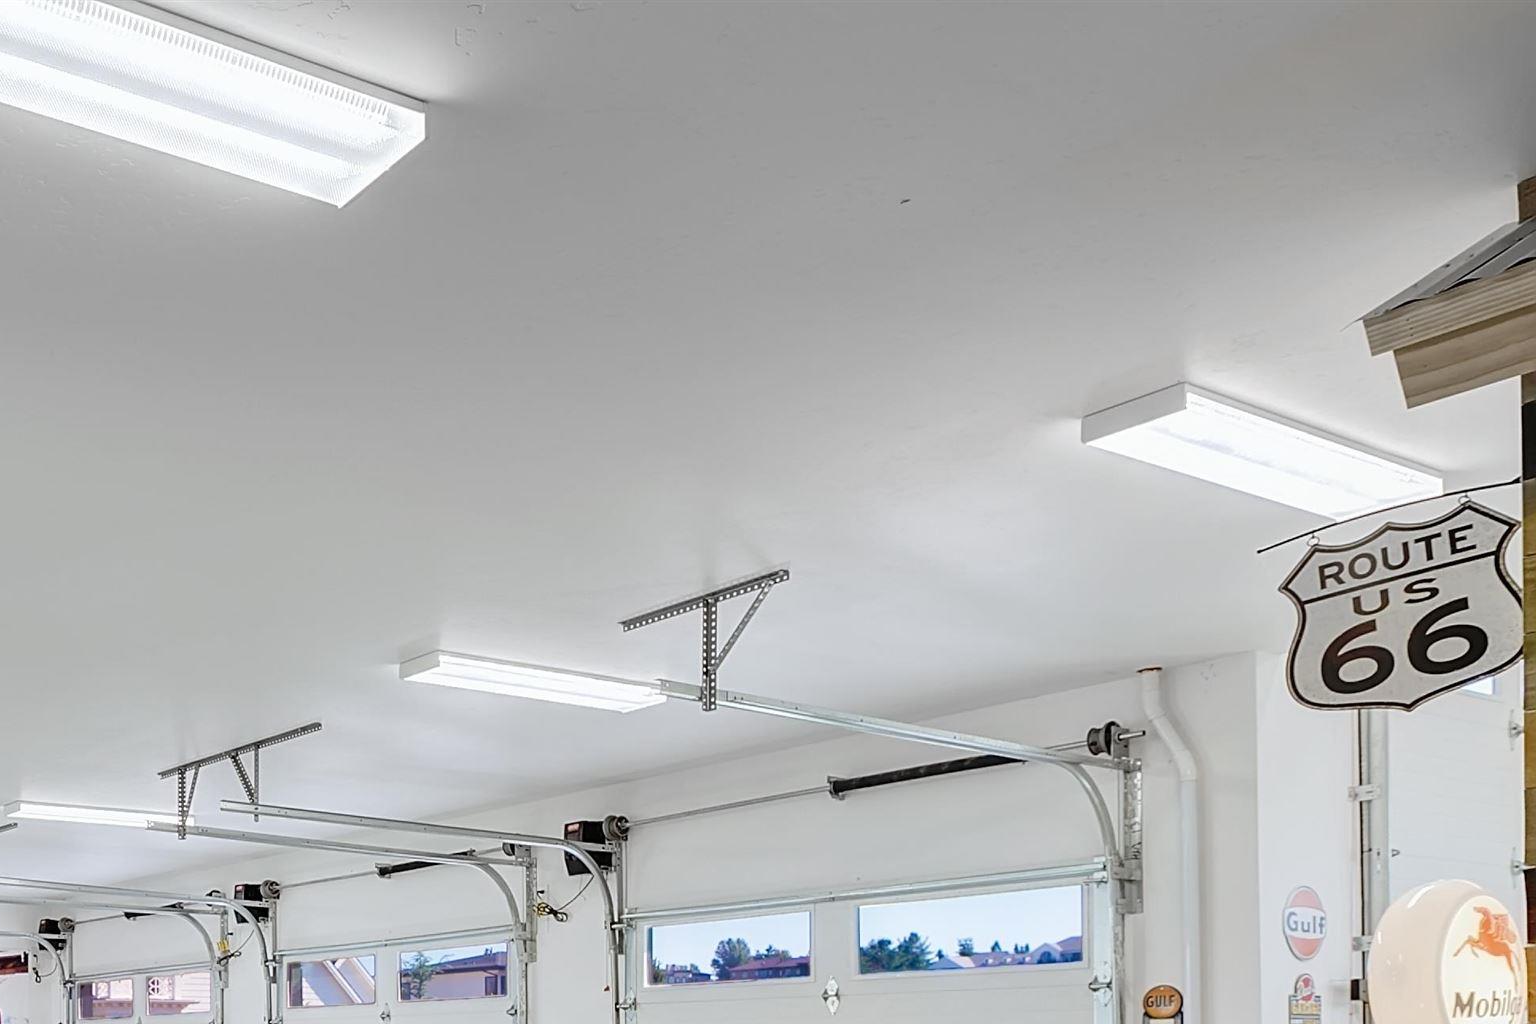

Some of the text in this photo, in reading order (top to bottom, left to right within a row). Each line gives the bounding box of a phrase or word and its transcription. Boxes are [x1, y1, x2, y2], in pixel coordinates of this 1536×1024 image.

[1318, 524, 1477, 590] ROUTE
[1352, 578, 1440, 616] US
[1321, 597, 1488, 694] 66
[1286, 911, 1326, 934] Gulf
[1146, 994, 1175, 1008] GULF
